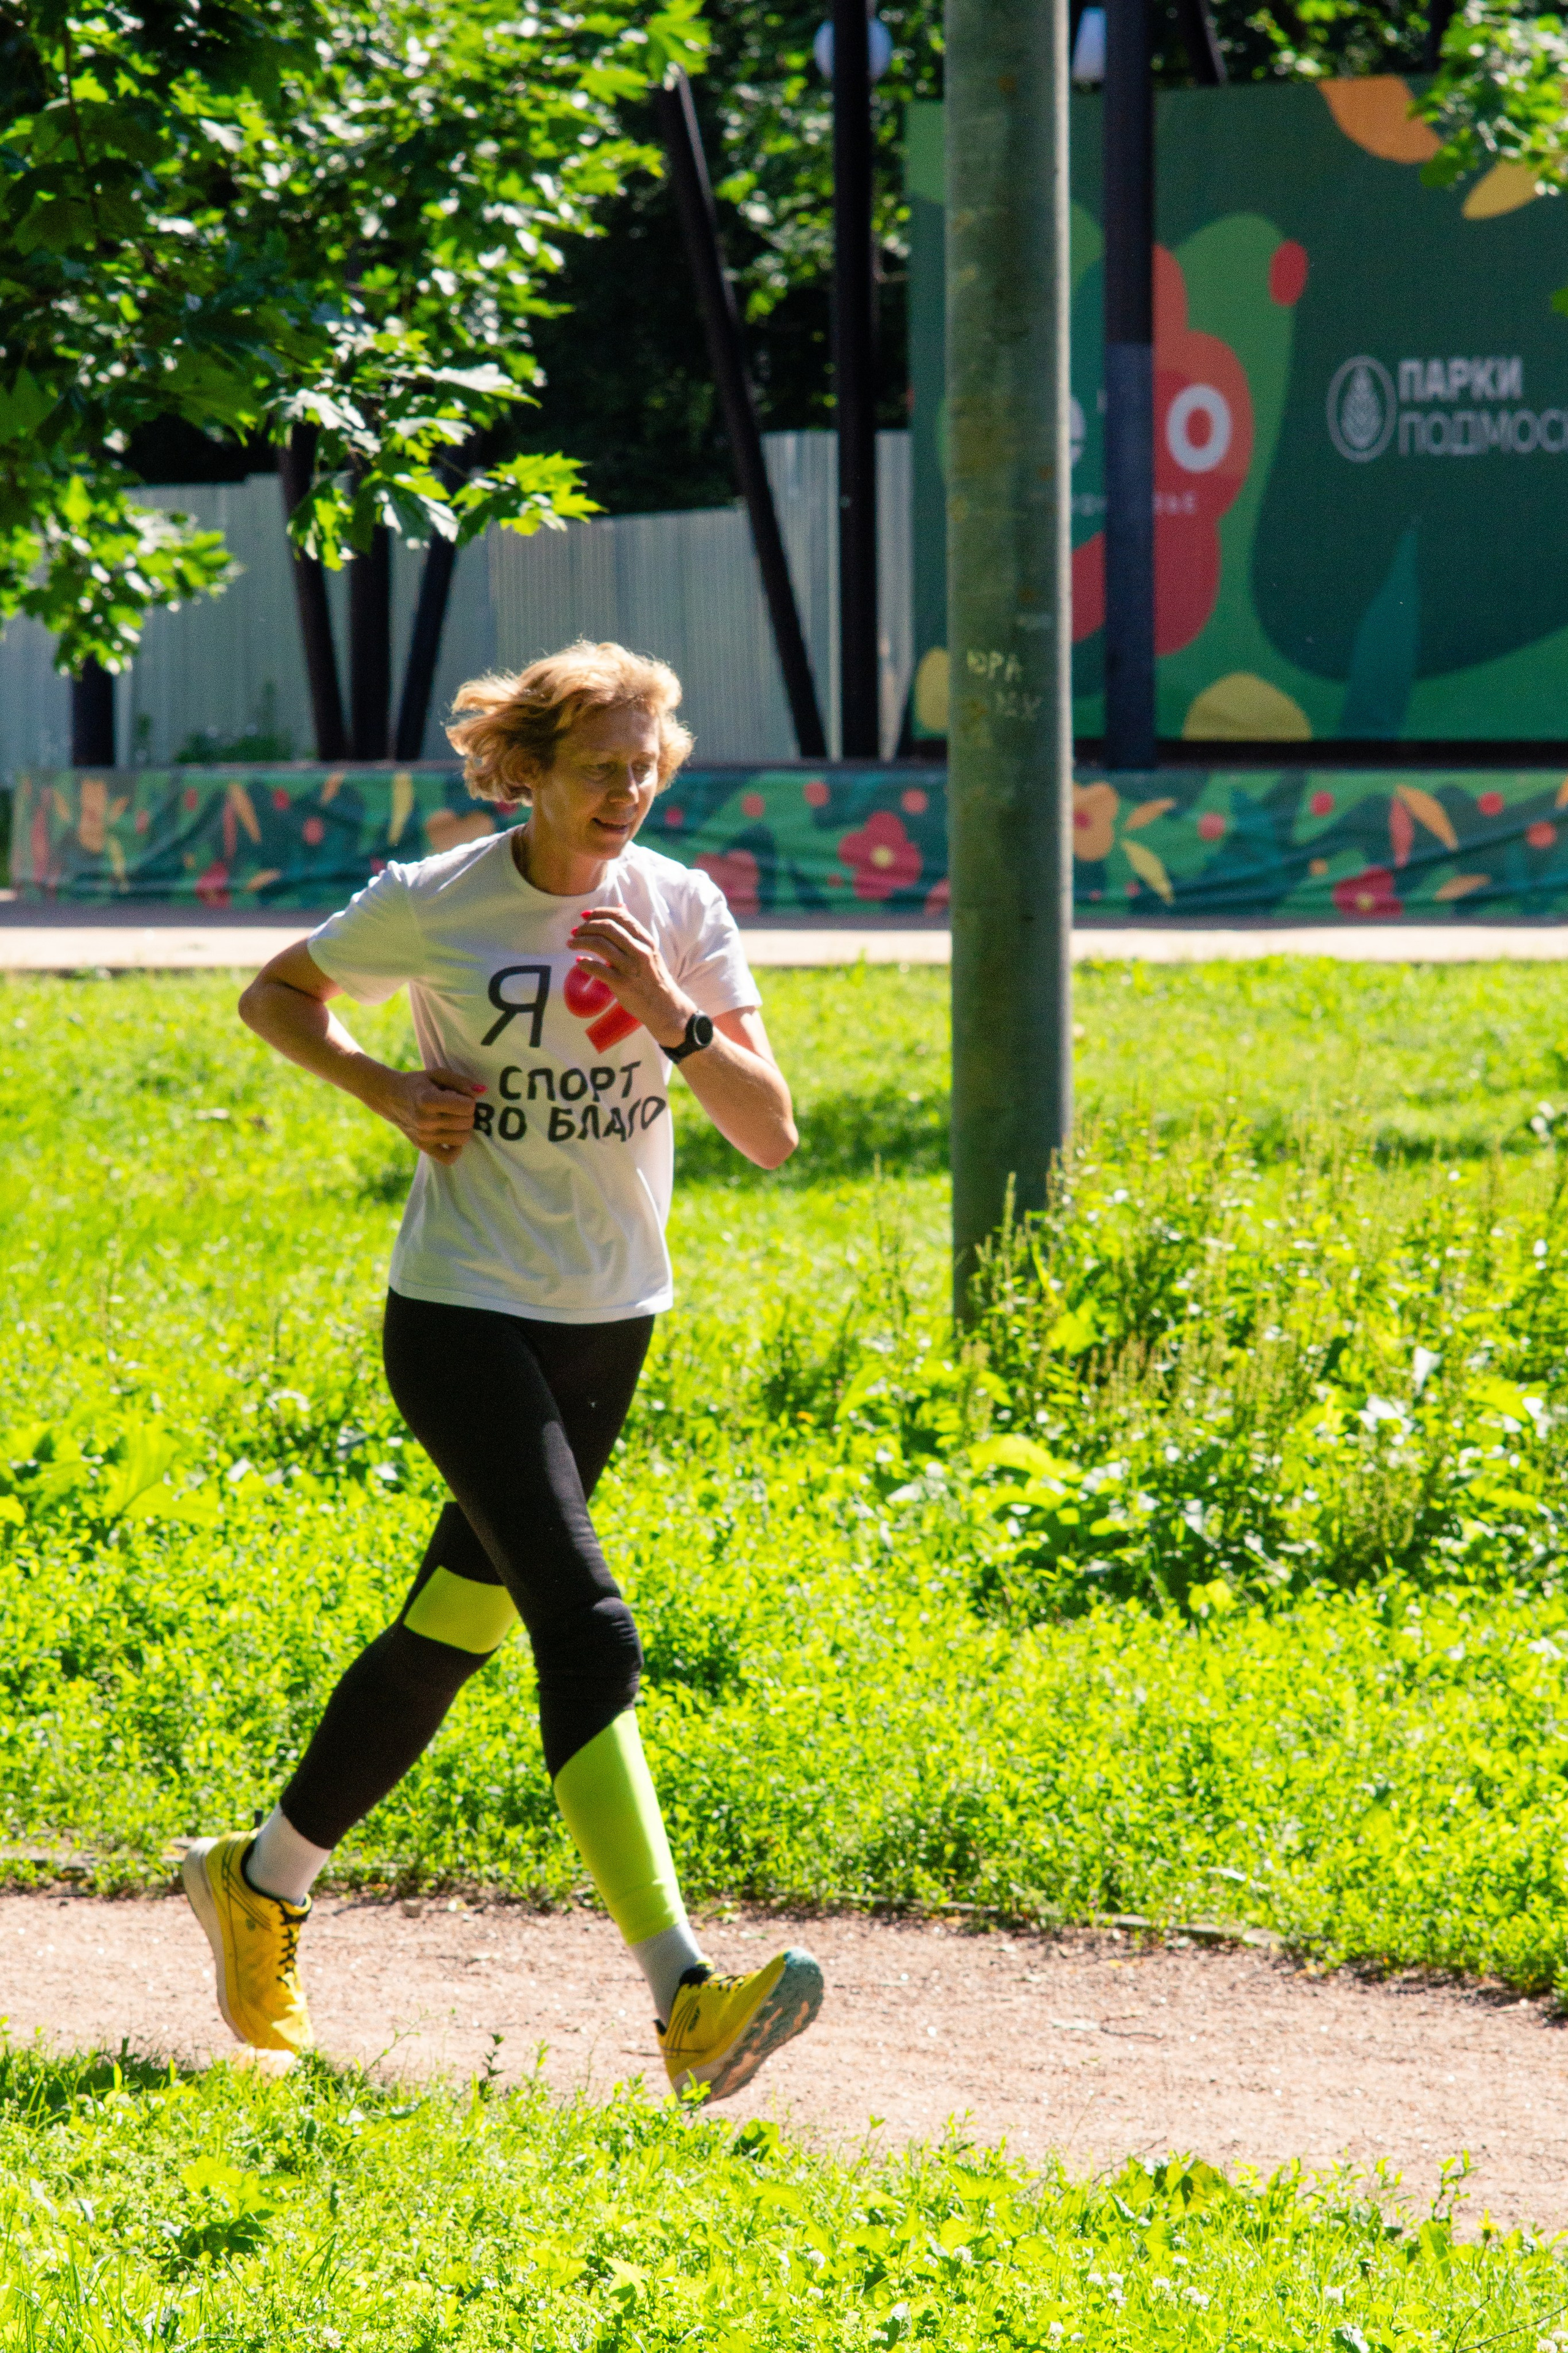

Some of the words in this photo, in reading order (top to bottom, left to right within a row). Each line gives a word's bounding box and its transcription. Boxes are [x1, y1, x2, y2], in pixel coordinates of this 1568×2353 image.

[1399, 358, 1523, 401] ПАРКИ
[1399, 409, 1568, 455] ПОДМОС
[481, 965, 551, 1048] Я
[499, 1060, 641, 1101] СПОРТ
[473, 1102, 527, 1141] ВО
[548, 1096, 666, 1143] БЛАГО
